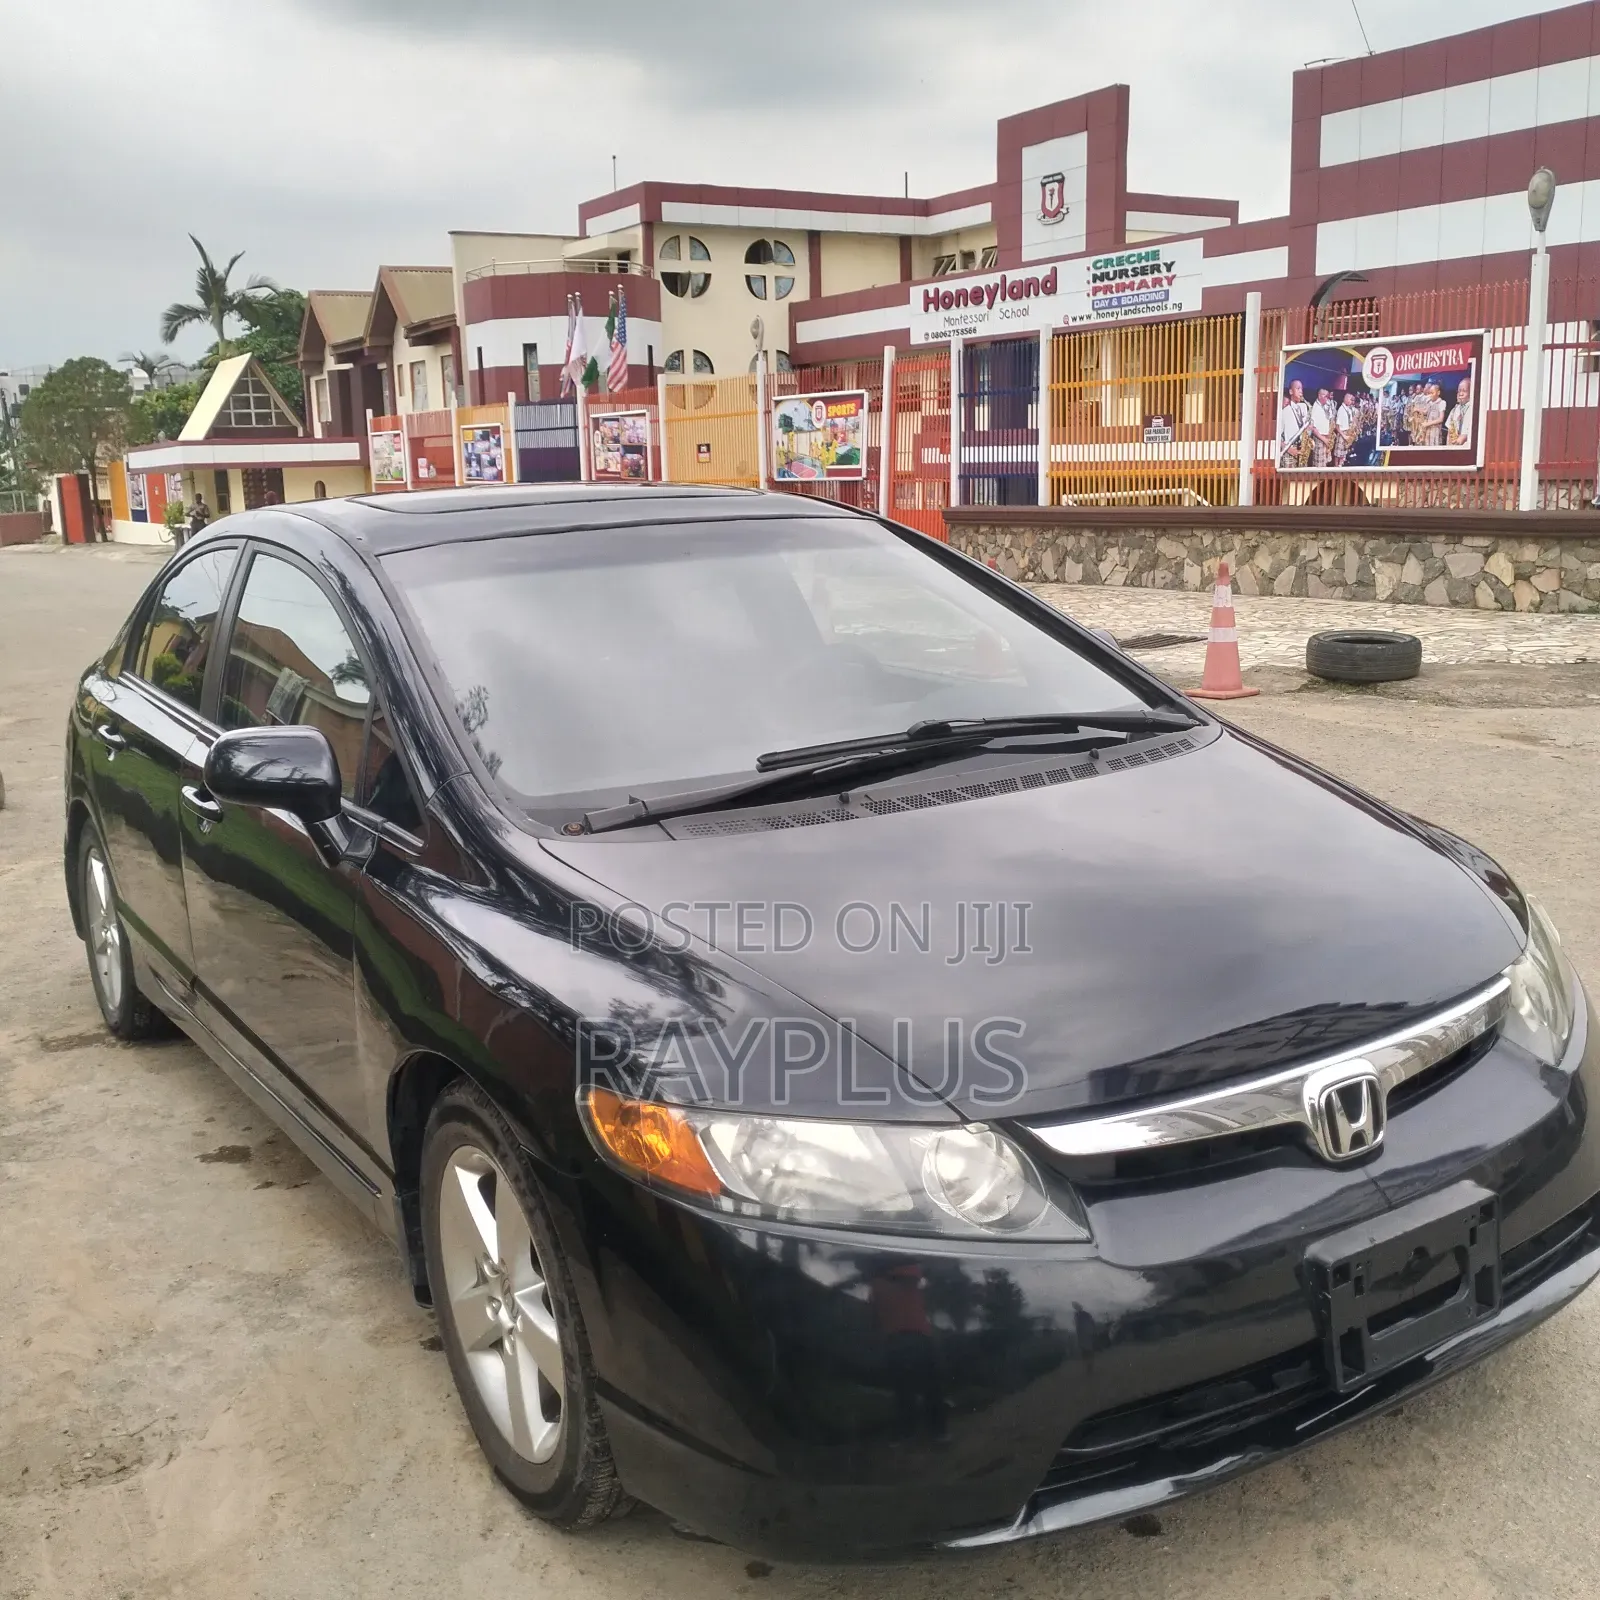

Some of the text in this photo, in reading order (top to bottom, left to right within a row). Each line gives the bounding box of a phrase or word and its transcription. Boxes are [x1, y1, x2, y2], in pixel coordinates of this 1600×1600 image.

[1092, 249, 1160, 270] CRECHE
[1092, 261, 1176, 283] NURSERY
[923, 266, 1057, 312] Honeyland
[1092, 274, 1177, 297] PRIMARY
[1094, 291, 1165, 309] DAY & BOARDING
[943, 305, 1030, 328] Montessori School
[1071, 302, 1183, 322] www.honeylandschools.ng
[1395, 348, 1464, 372] ORCHESTRA
[827, 403, 856, 417] SPORTS
